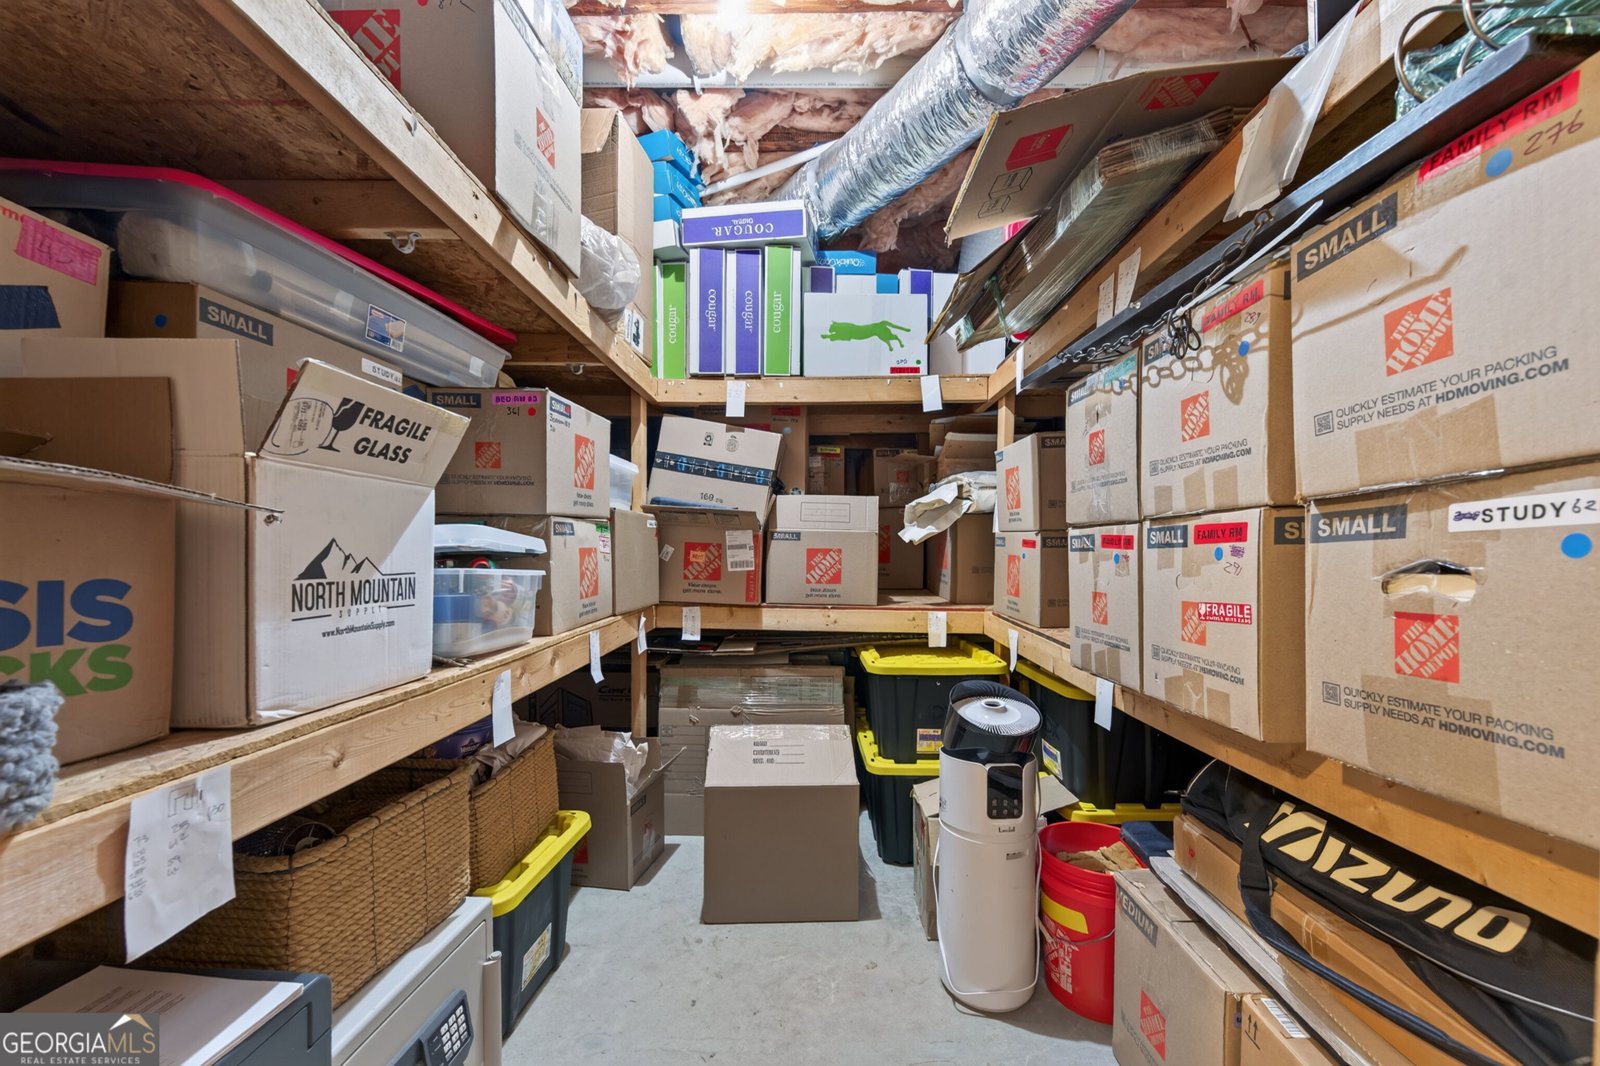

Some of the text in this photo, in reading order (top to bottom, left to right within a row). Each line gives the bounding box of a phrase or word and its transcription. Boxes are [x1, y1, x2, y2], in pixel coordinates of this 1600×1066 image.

[1428, 87, 1563, 171] FAMILY RM
[1523, 110, 1584, 156] 276
[714, 223, 774, 237] COUGAR
[1304, 210, 1387, 270] SMALL
[207, 305, 267, 340] SMALL
[668, 306, 680, 344] cougar
[705, 288, 717, 331] cougar
[741, 290, 753, 332] cougar
[772, 292, 784, 333] cougar
[1386, 291, 1453, 373] THE HOME DEPOT
[436, 394, 477, 406] SMALL
[1335, 345, 1558, 419] QUICKLY ESTIMATE YOUR PACKING
[1337, 358, 1570, 431] SUPPLY NEEDS AT HDMOVING.COM
[359, 407, 432, 442] FRAGILE
[353, 437, 413, 464] GLASS
[1317, 513, 1397, 537] SMALL
[1481, 501, 1567, 523] STUDY
[1150, 529, 1184, 544] SMALL
[1197, 527, 1243, 540] FAMILY RM
[291, 576, 416, 613] NORTH MOUNTAIN
[1206, 604, 1251, 618] FRAGILE
[1395, 615, 1460, 679] THE HOME DEPOT
[1343, 686, 1555, 741] QUICKLY ESTIMATE YOUR PACKING
[1343, 697, 1566, 759] SUPPLY NEEDS AT HDMOVING.COM
